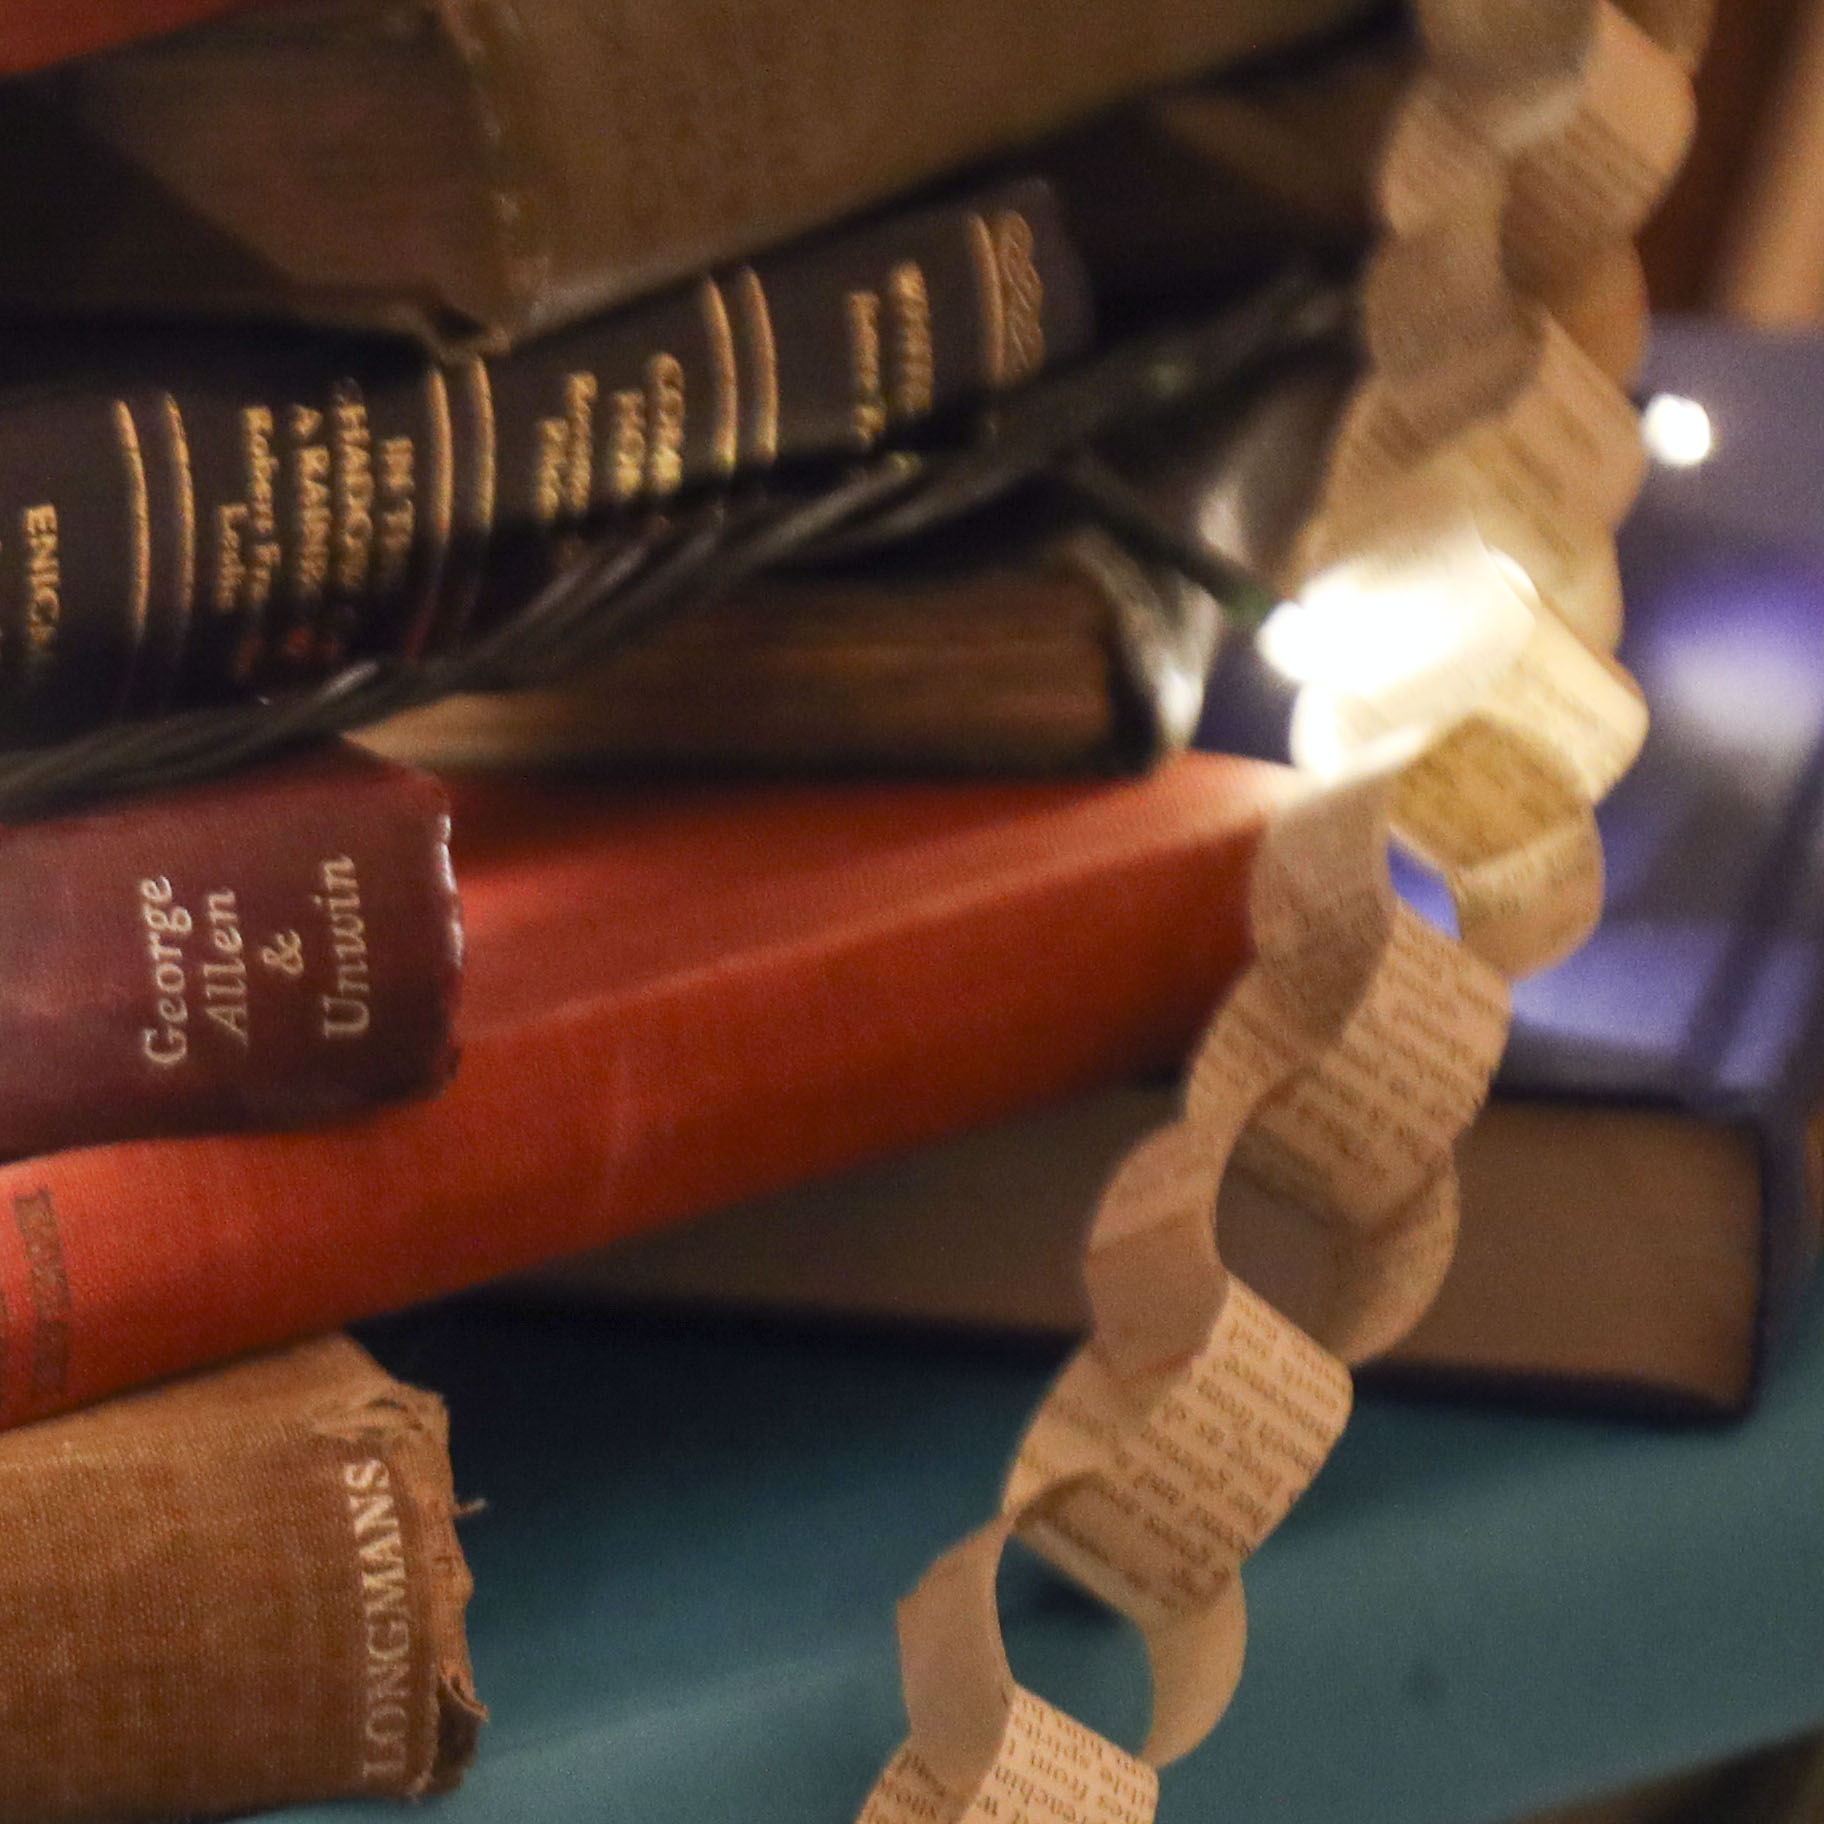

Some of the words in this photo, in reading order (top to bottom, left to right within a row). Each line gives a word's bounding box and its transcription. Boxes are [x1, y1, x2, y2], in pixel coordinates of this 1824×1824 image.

[145, 873, 186, 1071] George
[203, 886, 247, 1049] Allen
[260, 929, 304, 974] &
[318, 853, 372, 1042] Unwin
[343, 1457, 412, 1784] LONGMANS
